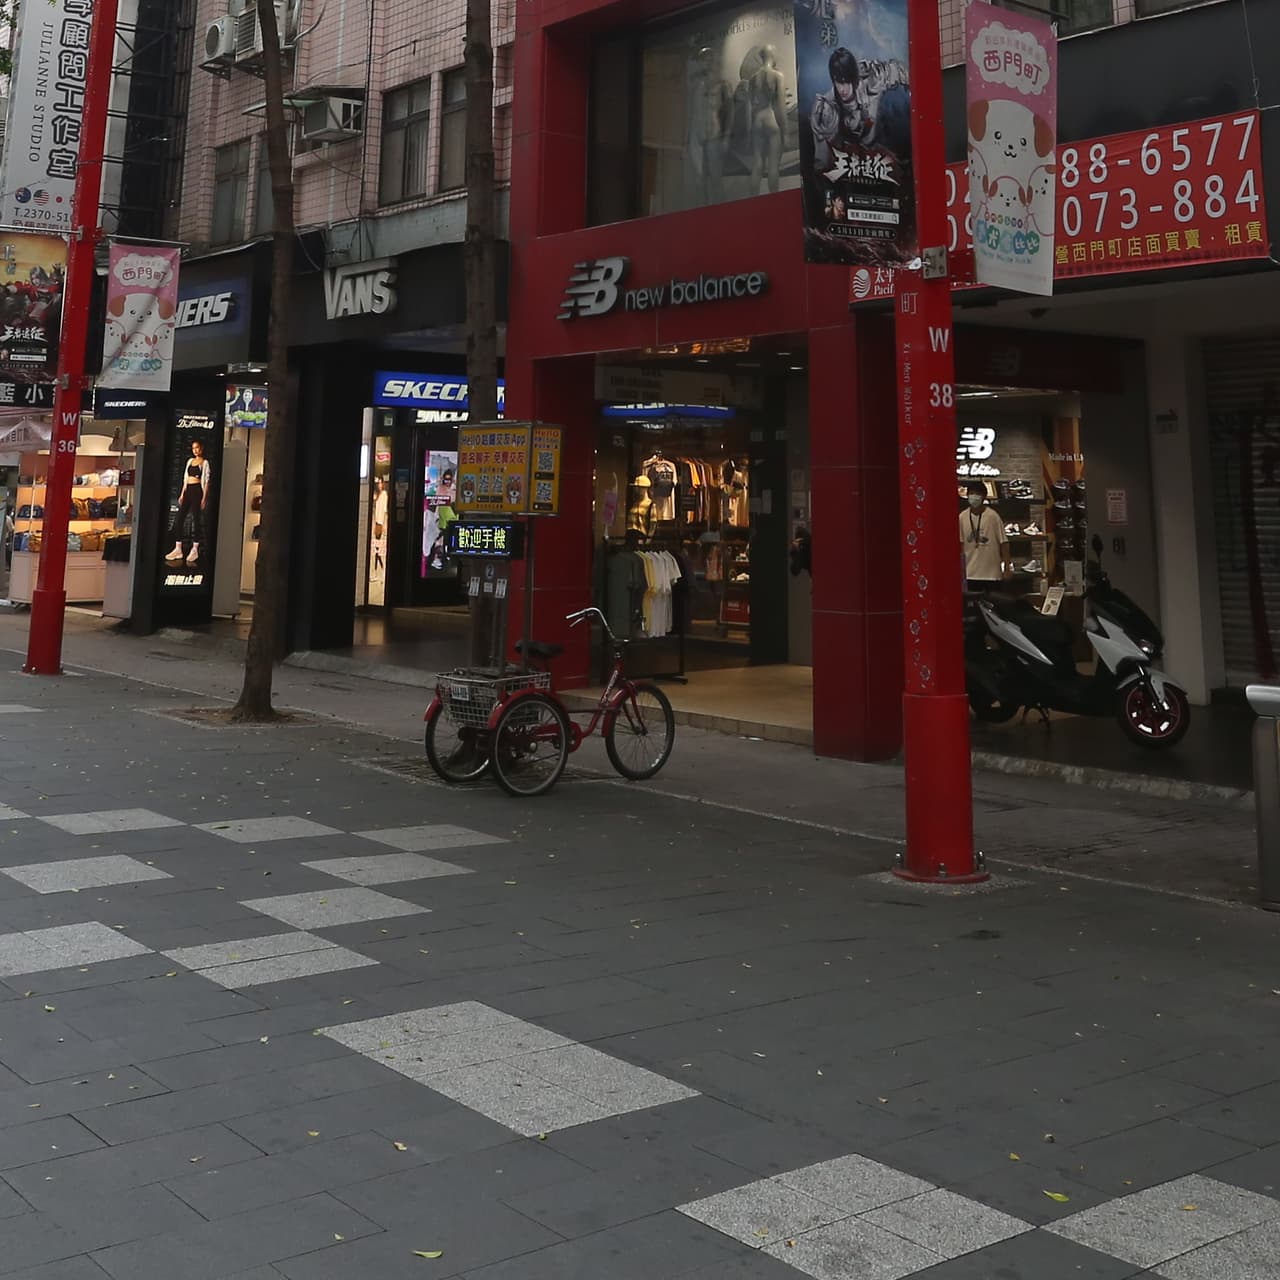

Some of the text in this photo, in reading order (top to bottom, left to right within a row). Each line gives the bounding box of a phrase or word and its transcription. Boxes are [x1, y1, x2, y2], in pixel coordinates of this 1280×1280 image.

[983, 49, 1043, 86] 西門町
[28, 22, 54, 163] JULIANNE STUDIO
[1060, 114, 1256, 188] 88-6577
[14, 207, 70, 220] T.2370-51
[1061, 169, 1260, 238] 073-884
[122, 267, 168, 283] 西門町
[323, 258, 397, 320] VANS
[625, 271, 764, 312] new balance
[901, 292, 919, 315] 町
[928, 326, 950, 353] W
[382, 379, 505, 403] SKECHR
[929, 383, 953, 408] 38
[62, 412, 78, 426] W
[58, 440, 76, 453] 36
[458, 527, 507, 550] 歡迎手機
